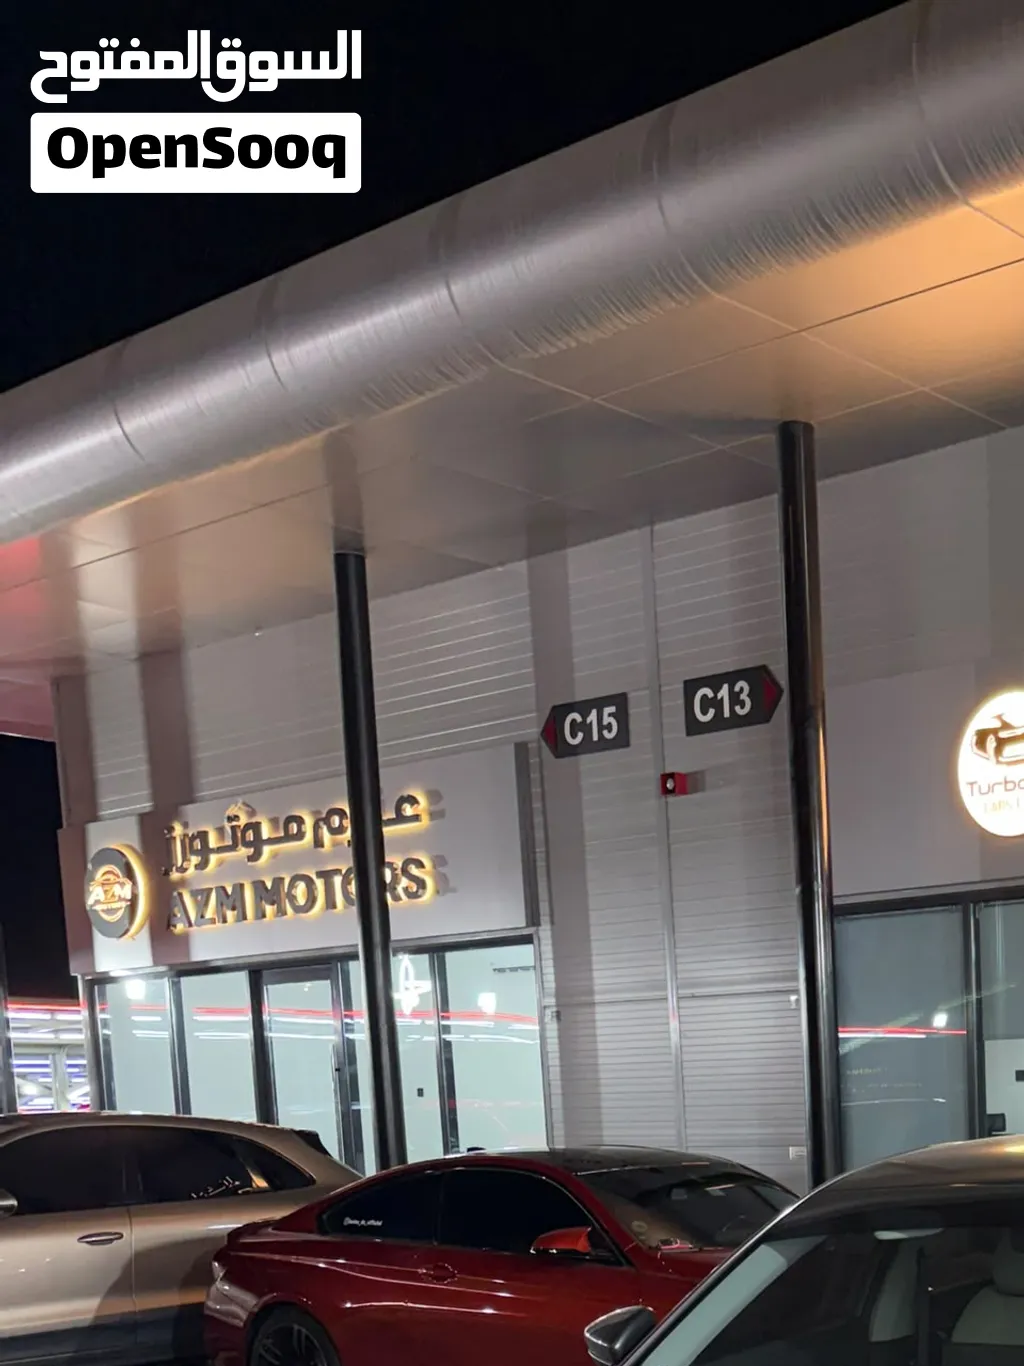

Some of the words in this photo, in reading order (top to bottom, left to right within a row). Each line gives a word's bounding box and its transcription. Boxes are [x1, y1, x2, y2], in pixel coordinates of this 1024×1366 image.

[694, 680, 752, 723] C13
[563, 705, 618, 746] C15
[166, 882, 247, 930] AZM
